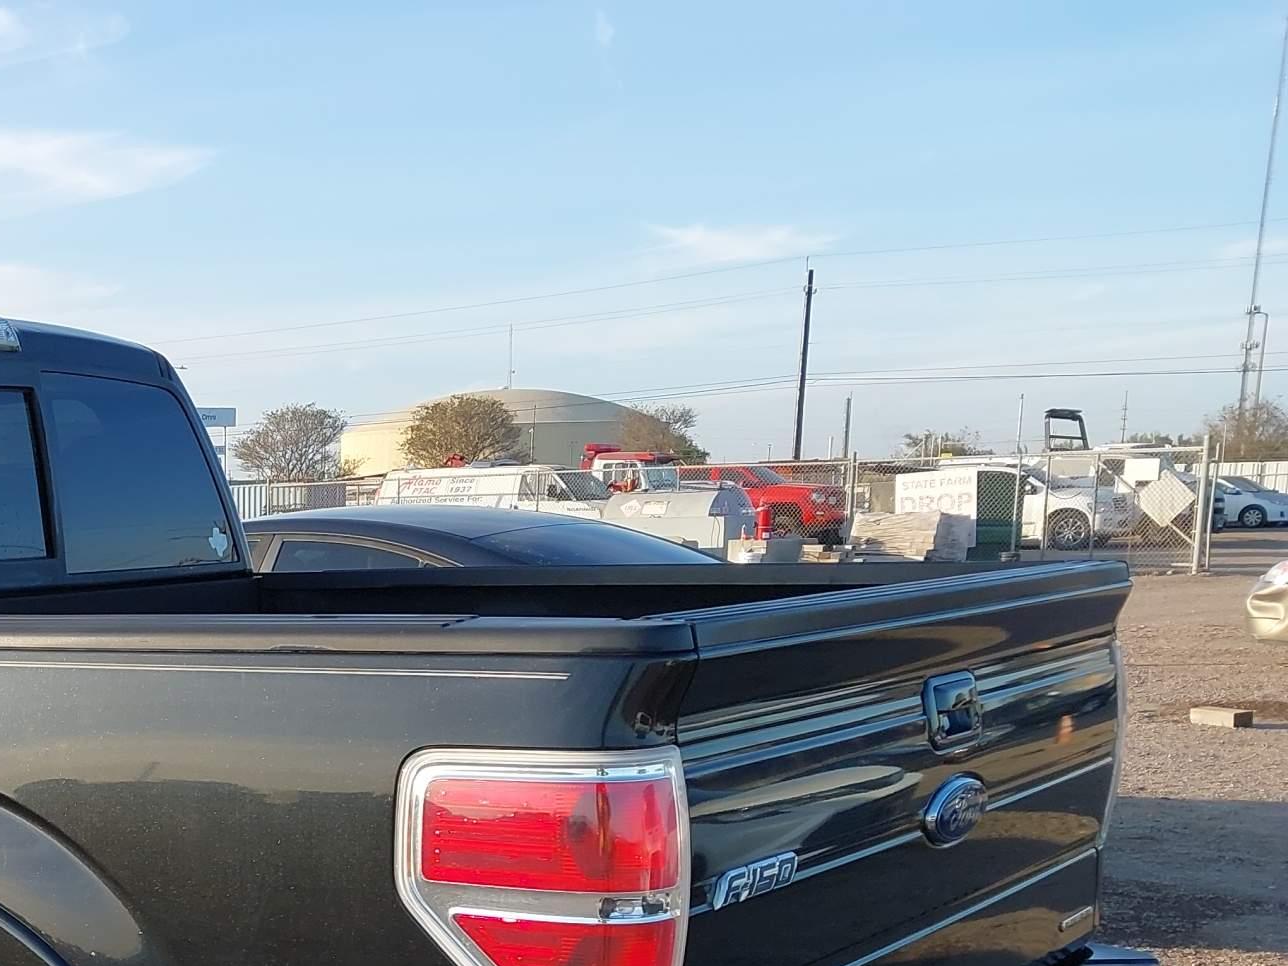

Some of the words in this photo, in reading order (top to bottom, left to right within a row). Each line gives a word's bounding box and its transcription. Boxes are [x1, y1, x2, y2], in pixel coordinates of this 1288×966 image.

[450, 477, 476, 485] Since
[901, 479, 937, 492] STATE
[939, 474, 973, 488] FARM
[449, 485, 473, 494] 1937
[435, 494, 465, 504] Service
[899, 492, 974, 513] DROP
